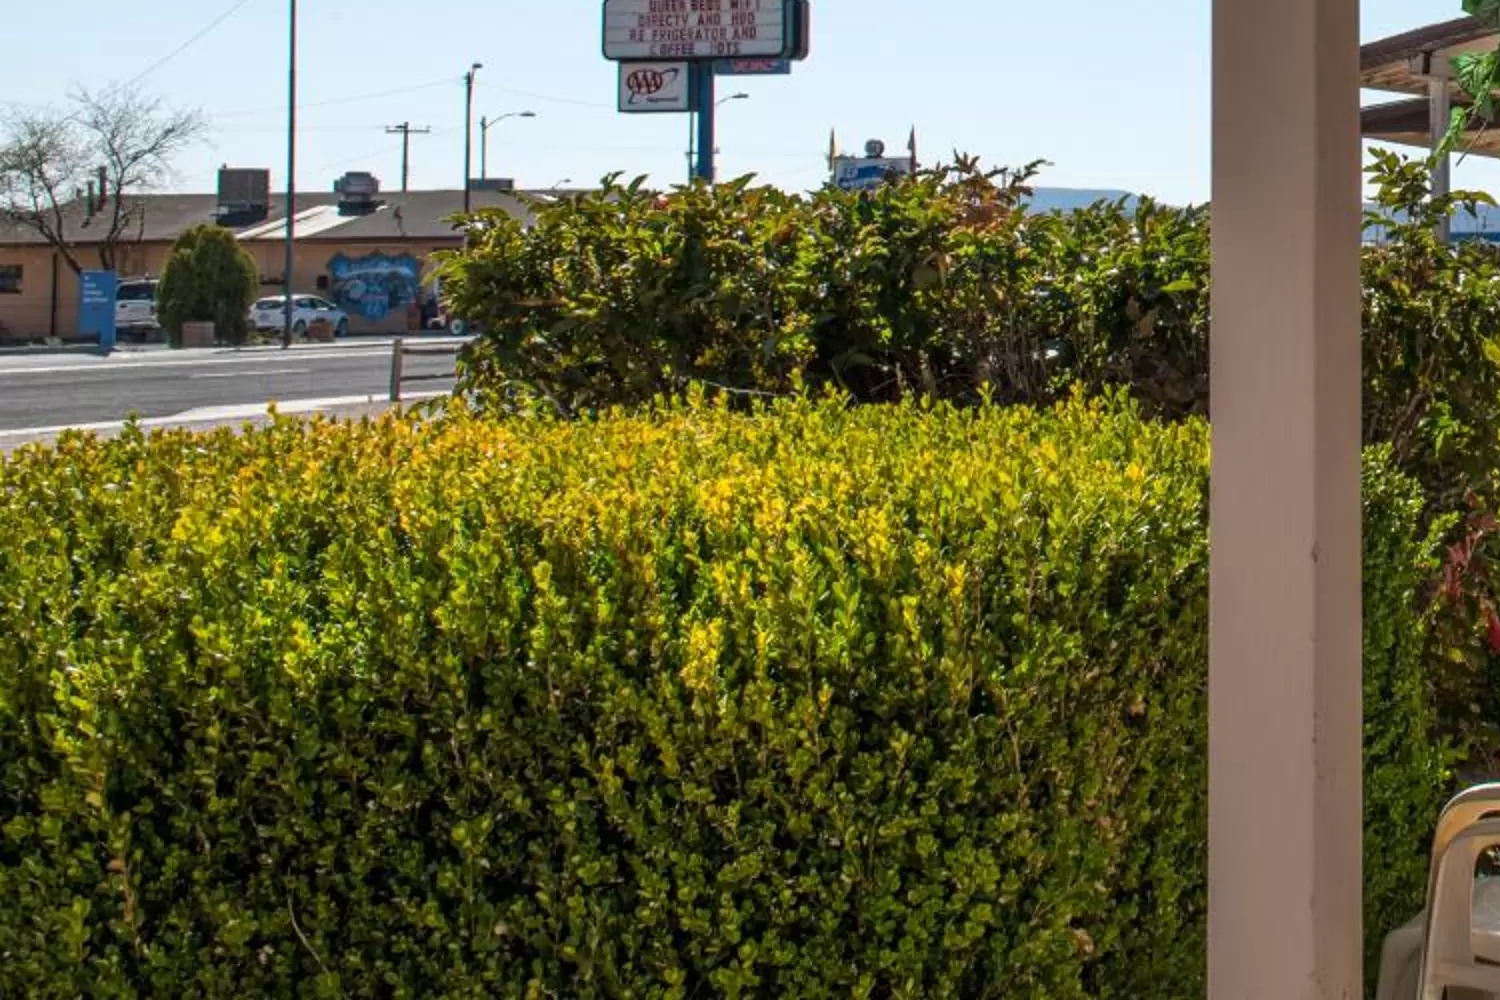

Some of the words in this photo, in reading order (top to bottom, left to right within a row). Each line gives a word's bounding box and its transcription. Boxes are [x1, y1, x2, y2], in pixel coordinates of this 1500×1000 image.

[691, 0, 720, 11] BEDS
[698, 14, 721, 25] AND
[732, 28, 757, 40] AND
